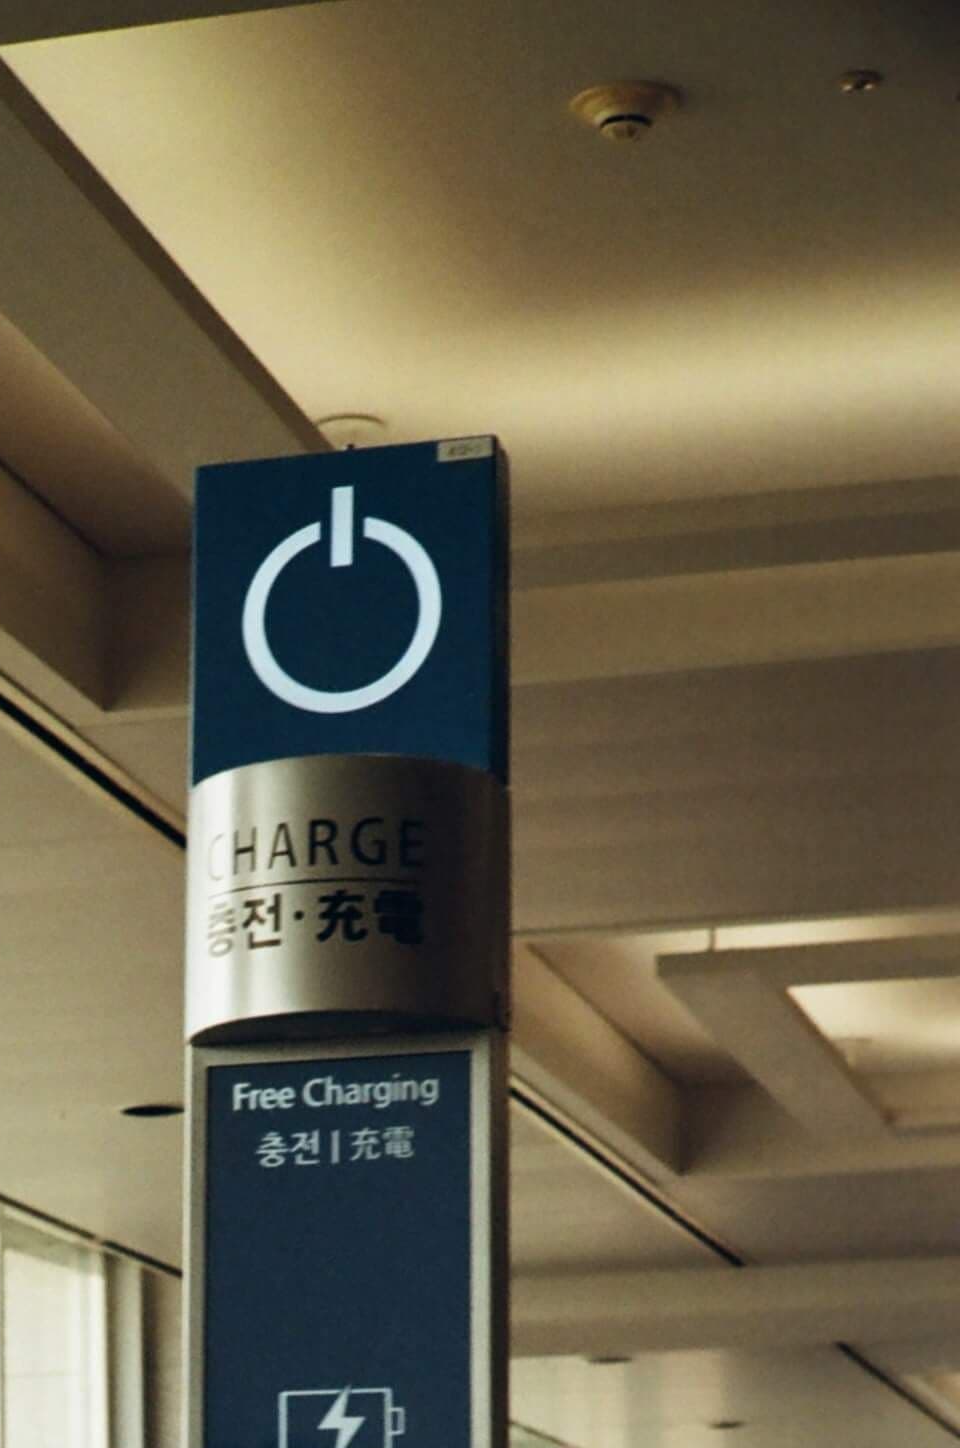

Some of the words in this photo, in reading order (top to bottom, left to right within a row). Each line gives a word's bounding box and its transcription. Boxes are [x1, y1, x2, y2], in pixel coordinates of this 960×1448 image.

[208, 816, 424, 881] CHARGE
[232, 1081, 296, 1111] Free
[302, 1073, 440, 1109] Charging
